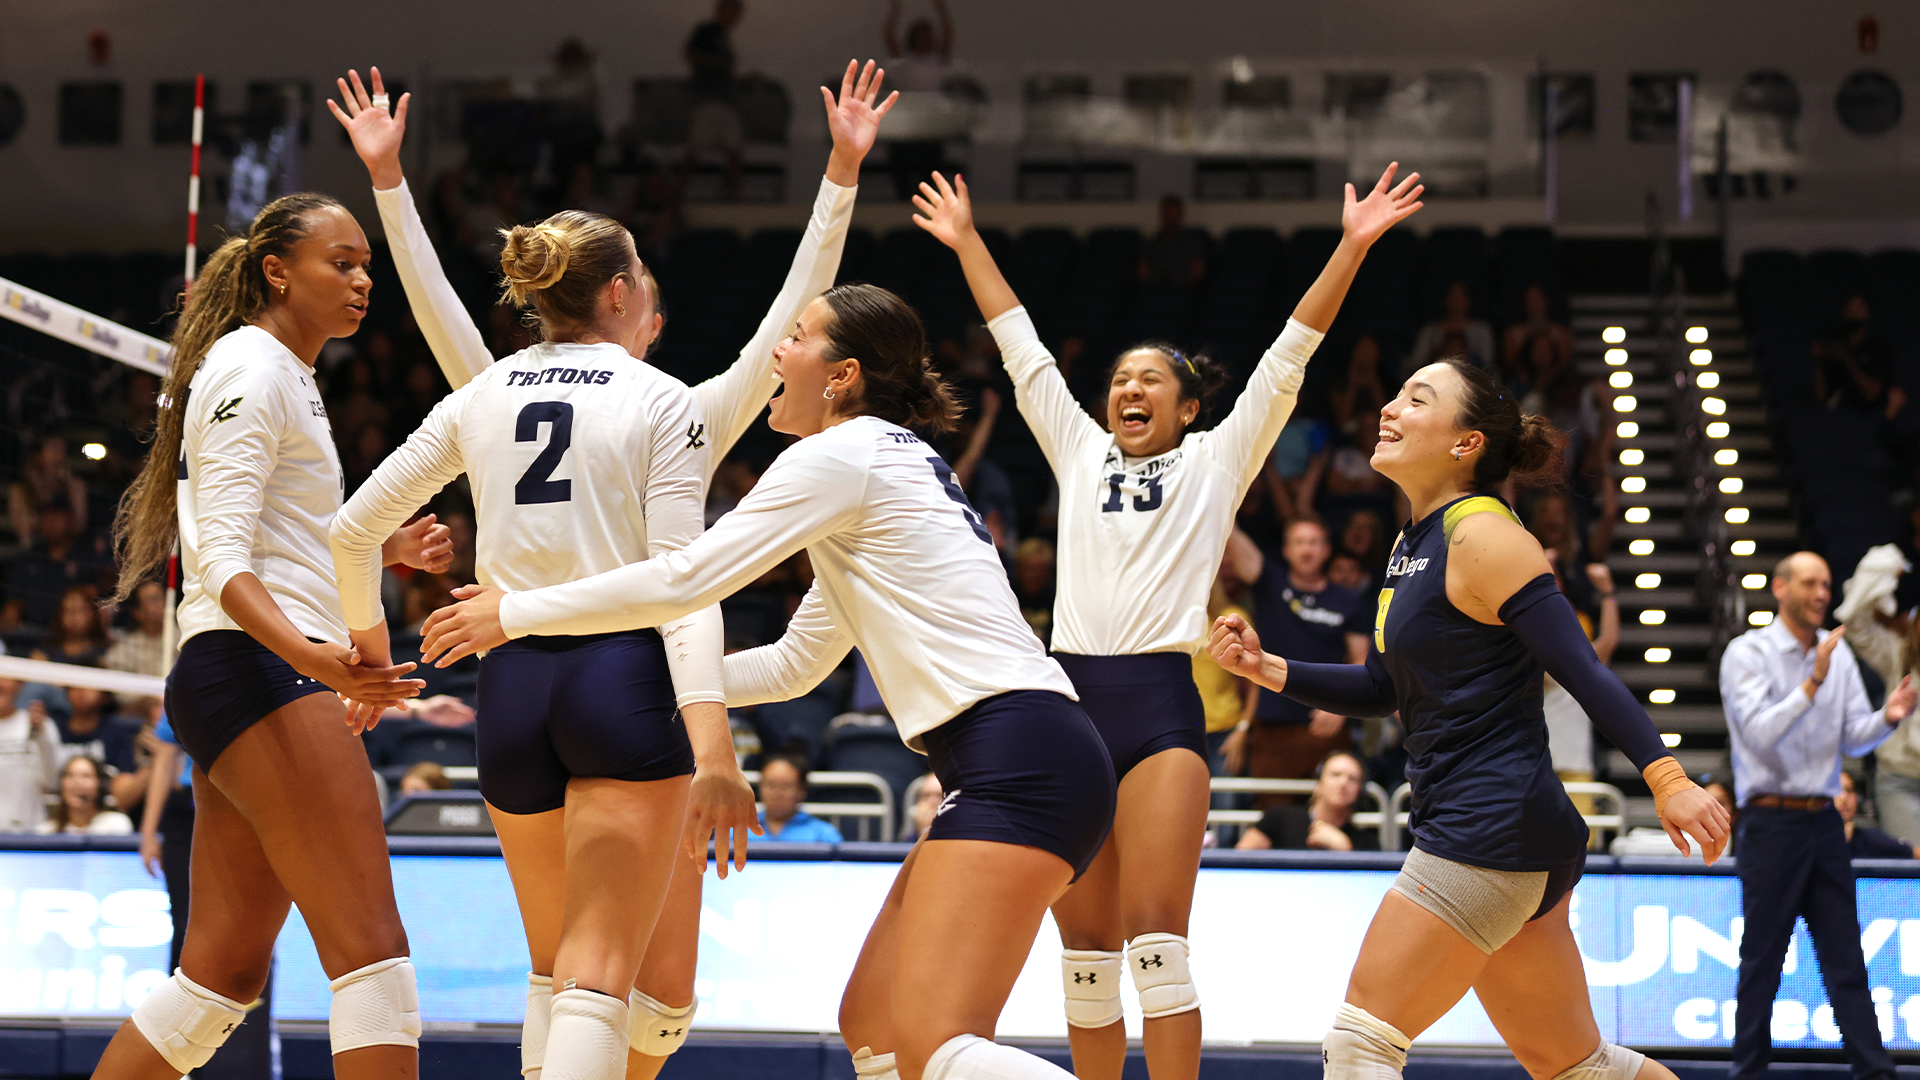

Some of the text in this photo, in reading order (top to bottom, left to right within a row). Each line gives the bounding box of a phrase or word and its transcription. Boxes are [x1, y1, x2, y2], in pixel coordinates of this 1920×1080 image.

[506, 367, 615, 387] TRITONS
[514, 400, 574, 505] 2
[1102, 472, 1163, 513] 13
